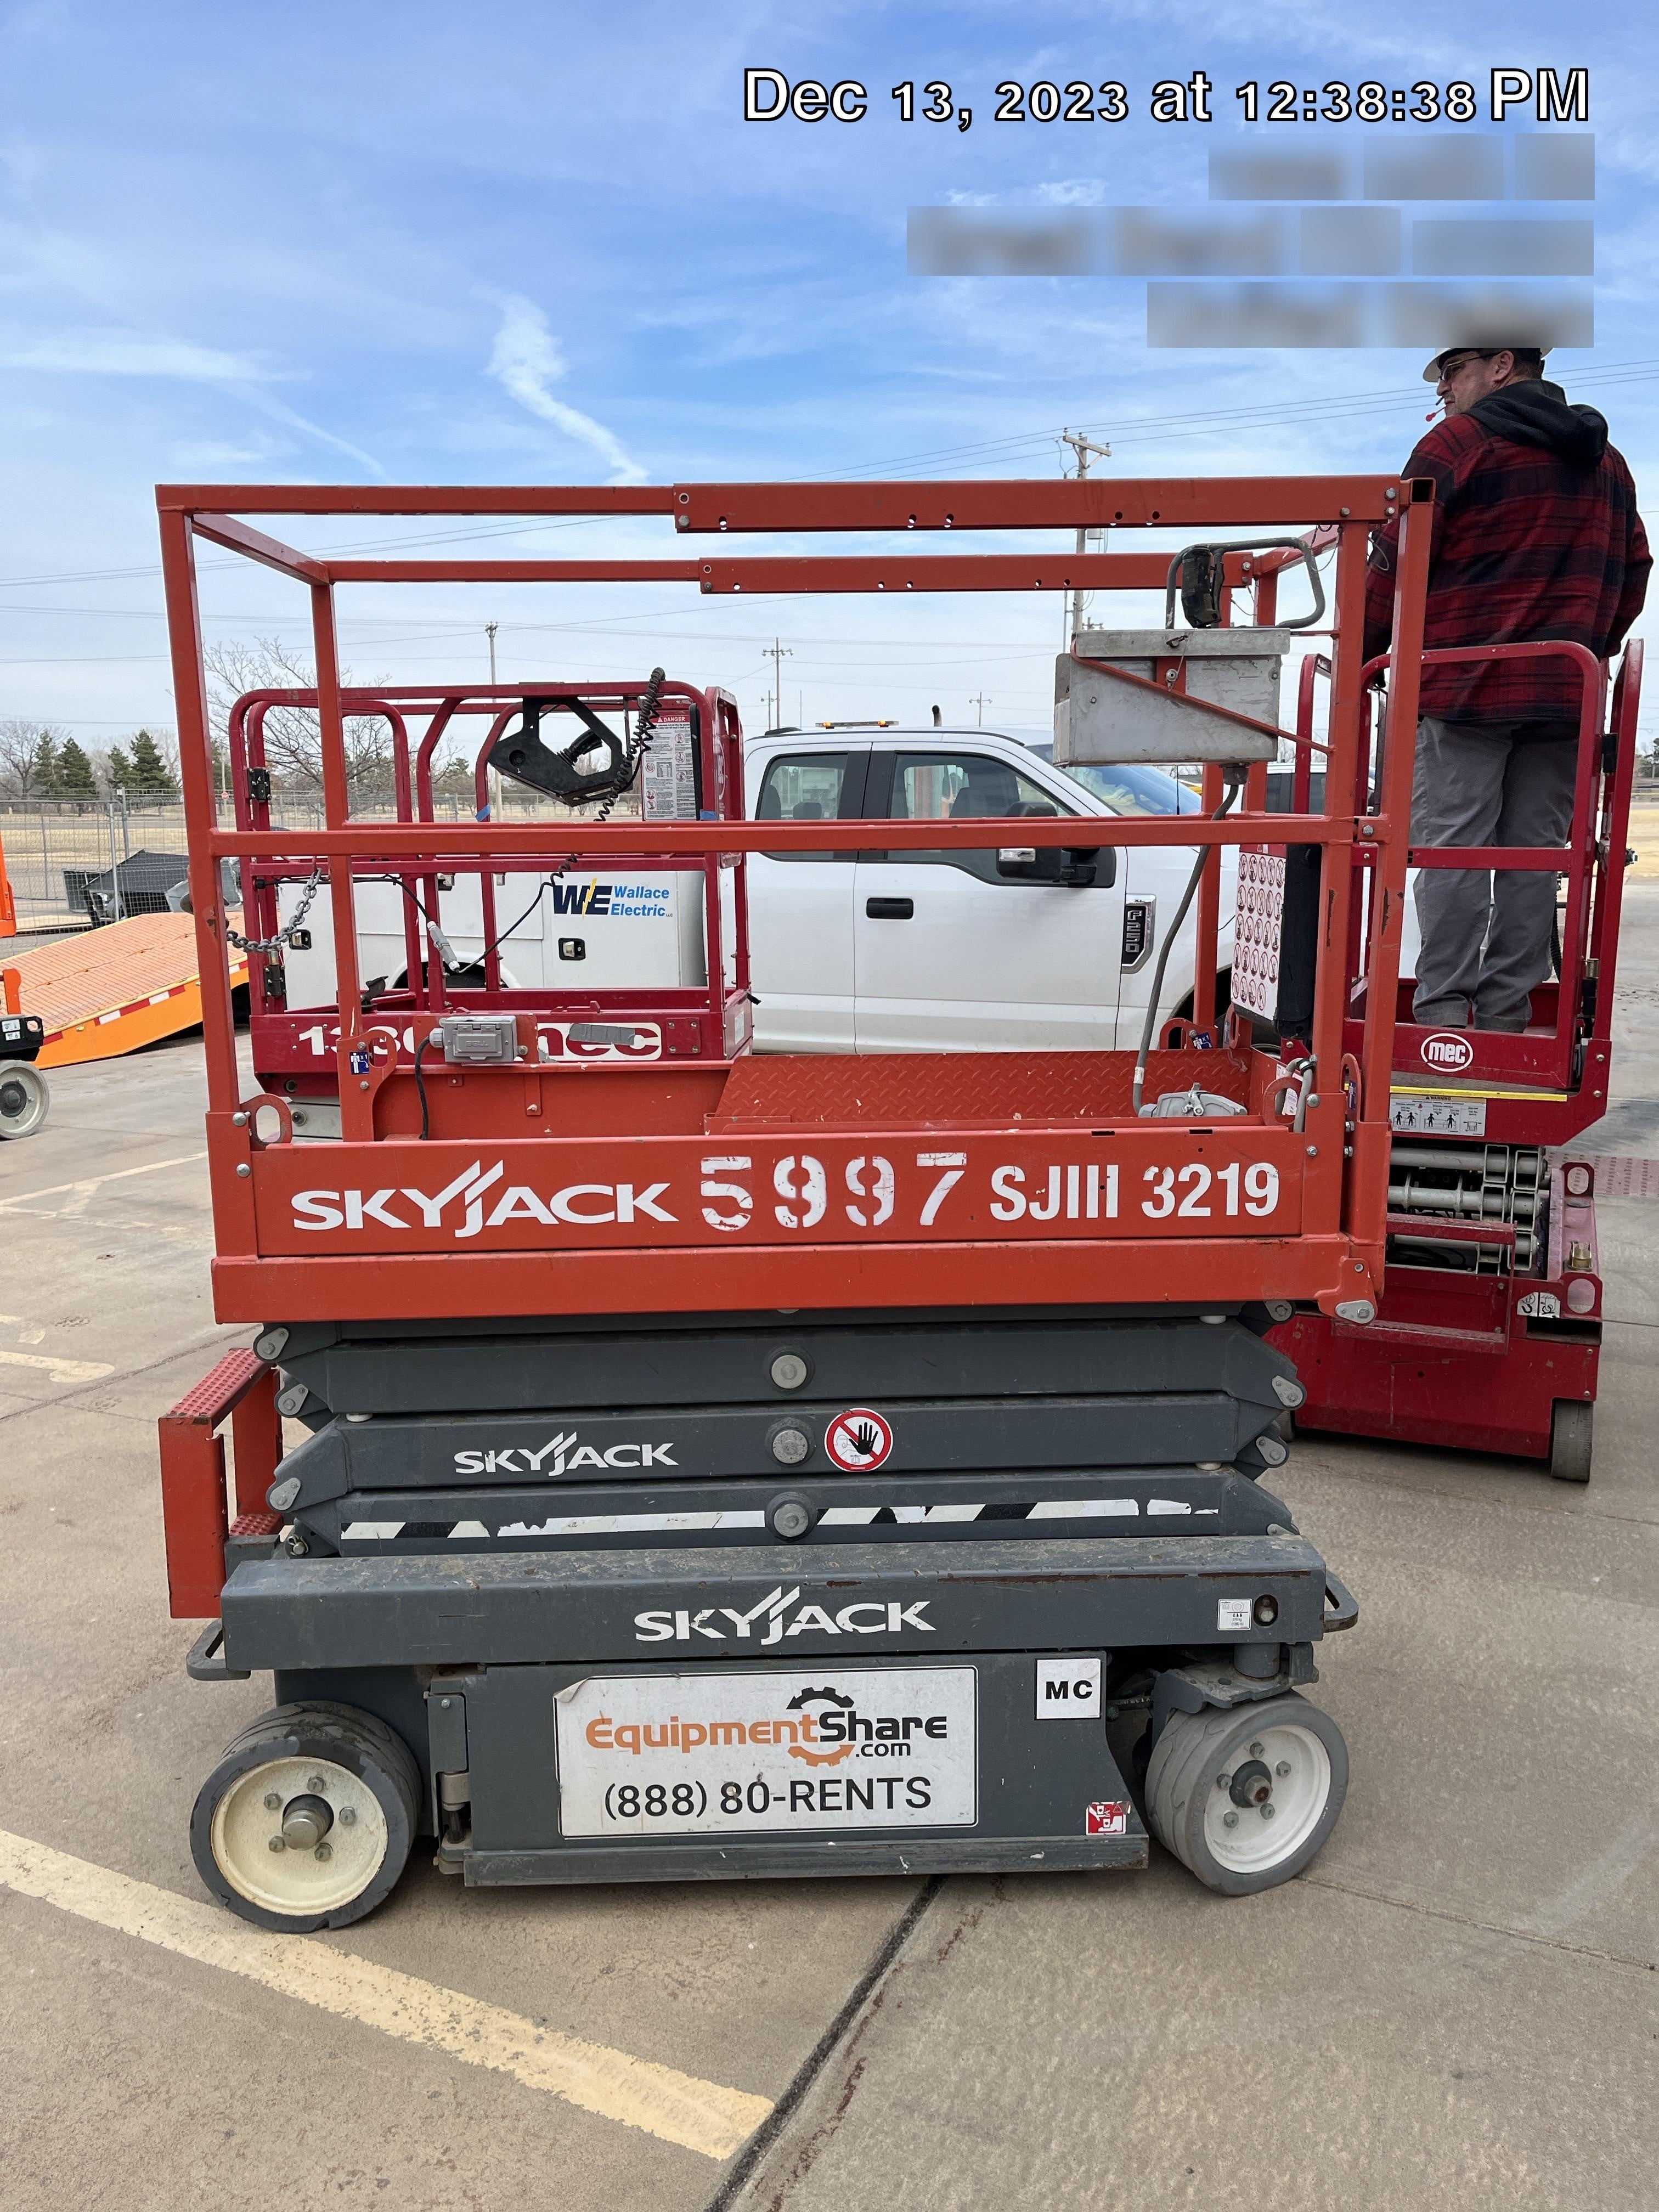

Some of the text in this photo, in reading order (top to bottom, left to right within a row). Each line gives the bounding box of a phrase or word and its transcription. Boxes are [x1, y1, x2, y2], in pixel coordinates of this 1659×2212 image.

[614, 885, 670, 899] Wallace
[611, 903, 665, 917] Electric
[1429, 1042, 1466, 1063] mec
[291, 1152, 1279, 1238] SKYJACK 5997 SJIII 3219
[453, 1431, 680, 1477] SKYJACK
[634, 1585, 938, 1646] SKYJACK
[1045, 1680, 1093, 1700] MC
[585, 1711, 948, 1755] EquipmentShare
[855, 1742, 911, 1758] .com
[605, 1776, 932, 1821] (888) 80-RENTS
